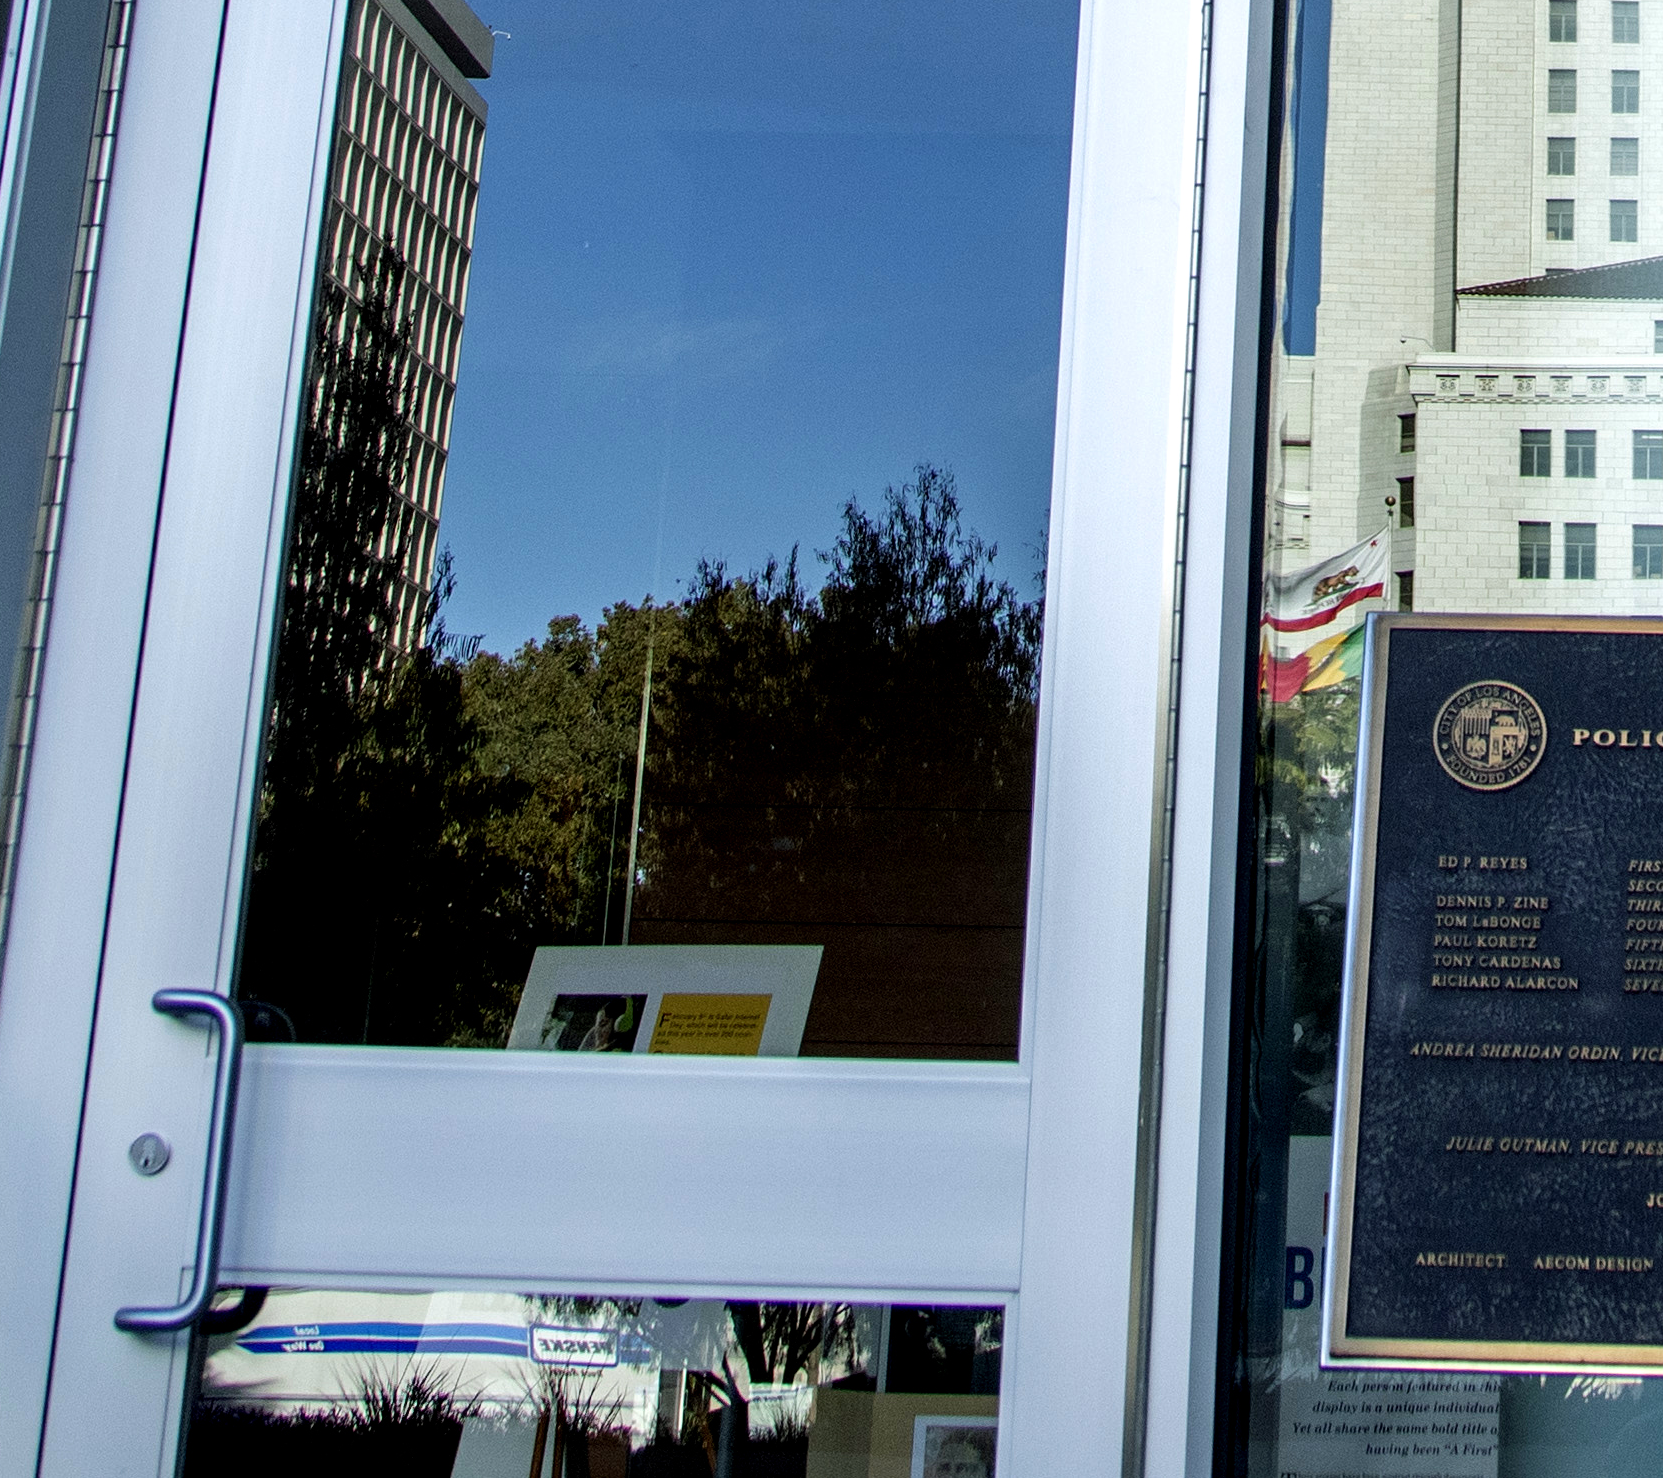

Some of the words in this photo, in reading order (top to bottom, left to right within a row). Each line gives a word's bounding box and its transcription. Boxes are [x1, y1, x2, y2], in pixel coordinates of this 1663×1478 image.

[1438, 855, 1458, 869] ED
[1479, 856, 1528, 870] REYES
[1436, 895, 1492, 909] DENNIS
[1513, 897, 1550, 911] ZINE
[1435, 914, 1468, 928] TOM
[1434, 934, 1472, 948] PAUL
[1477, 936, 1538, 950] KORETZ
[1433, 954, 1474, 968] TONY
[1478, 955, 1562, 970] CARDENAS
[1431, 975, 1501, 989] RICHARD
[1505, 976, 1579, 991] ALARCON
[1409, 1042, 1475, 1057] ANDREA
[1480, 1044, 1563, 1060] SHERIDAN
[1445, 1136, 1494, 1151] JULIE
[1580, 1139, 1619, 1154] VICE
[1416, 1252, 1507, 1268] ARCHITECT
[1533, 1255, 1591, 1270] AECOM
[1595, 1256, 1654, 1272] DESIGN
[1327, 1379, 1360, 1393] Each
[1361, 1382, 1404, 1396] person
[1406, 1380, 1460, 1396] featured
[1463, 1381, 1477, 1393] in
[1312, 1401, 1358, 1416] display
[1360, 1402, 1373, 1414] is
[1375, 1404, 1383, 1414] a
[1387, 1402, 1431, 1417] unique
[1292, 1422, 1312, 1434] Yet
[1314, 1422, 1333, 1434] all
[1334, 1423, 1371, 1435] share
[1373, 1423, 1391, 1435] the
[1395, 1426, 1429, 1436] same
[1431, 1423, 1459, 1435] bold
[1462, 1423, 1488, 1435] title
[1365, 1443, 1409, 1458] having
[1412, 1444, 1441, 1456] been
